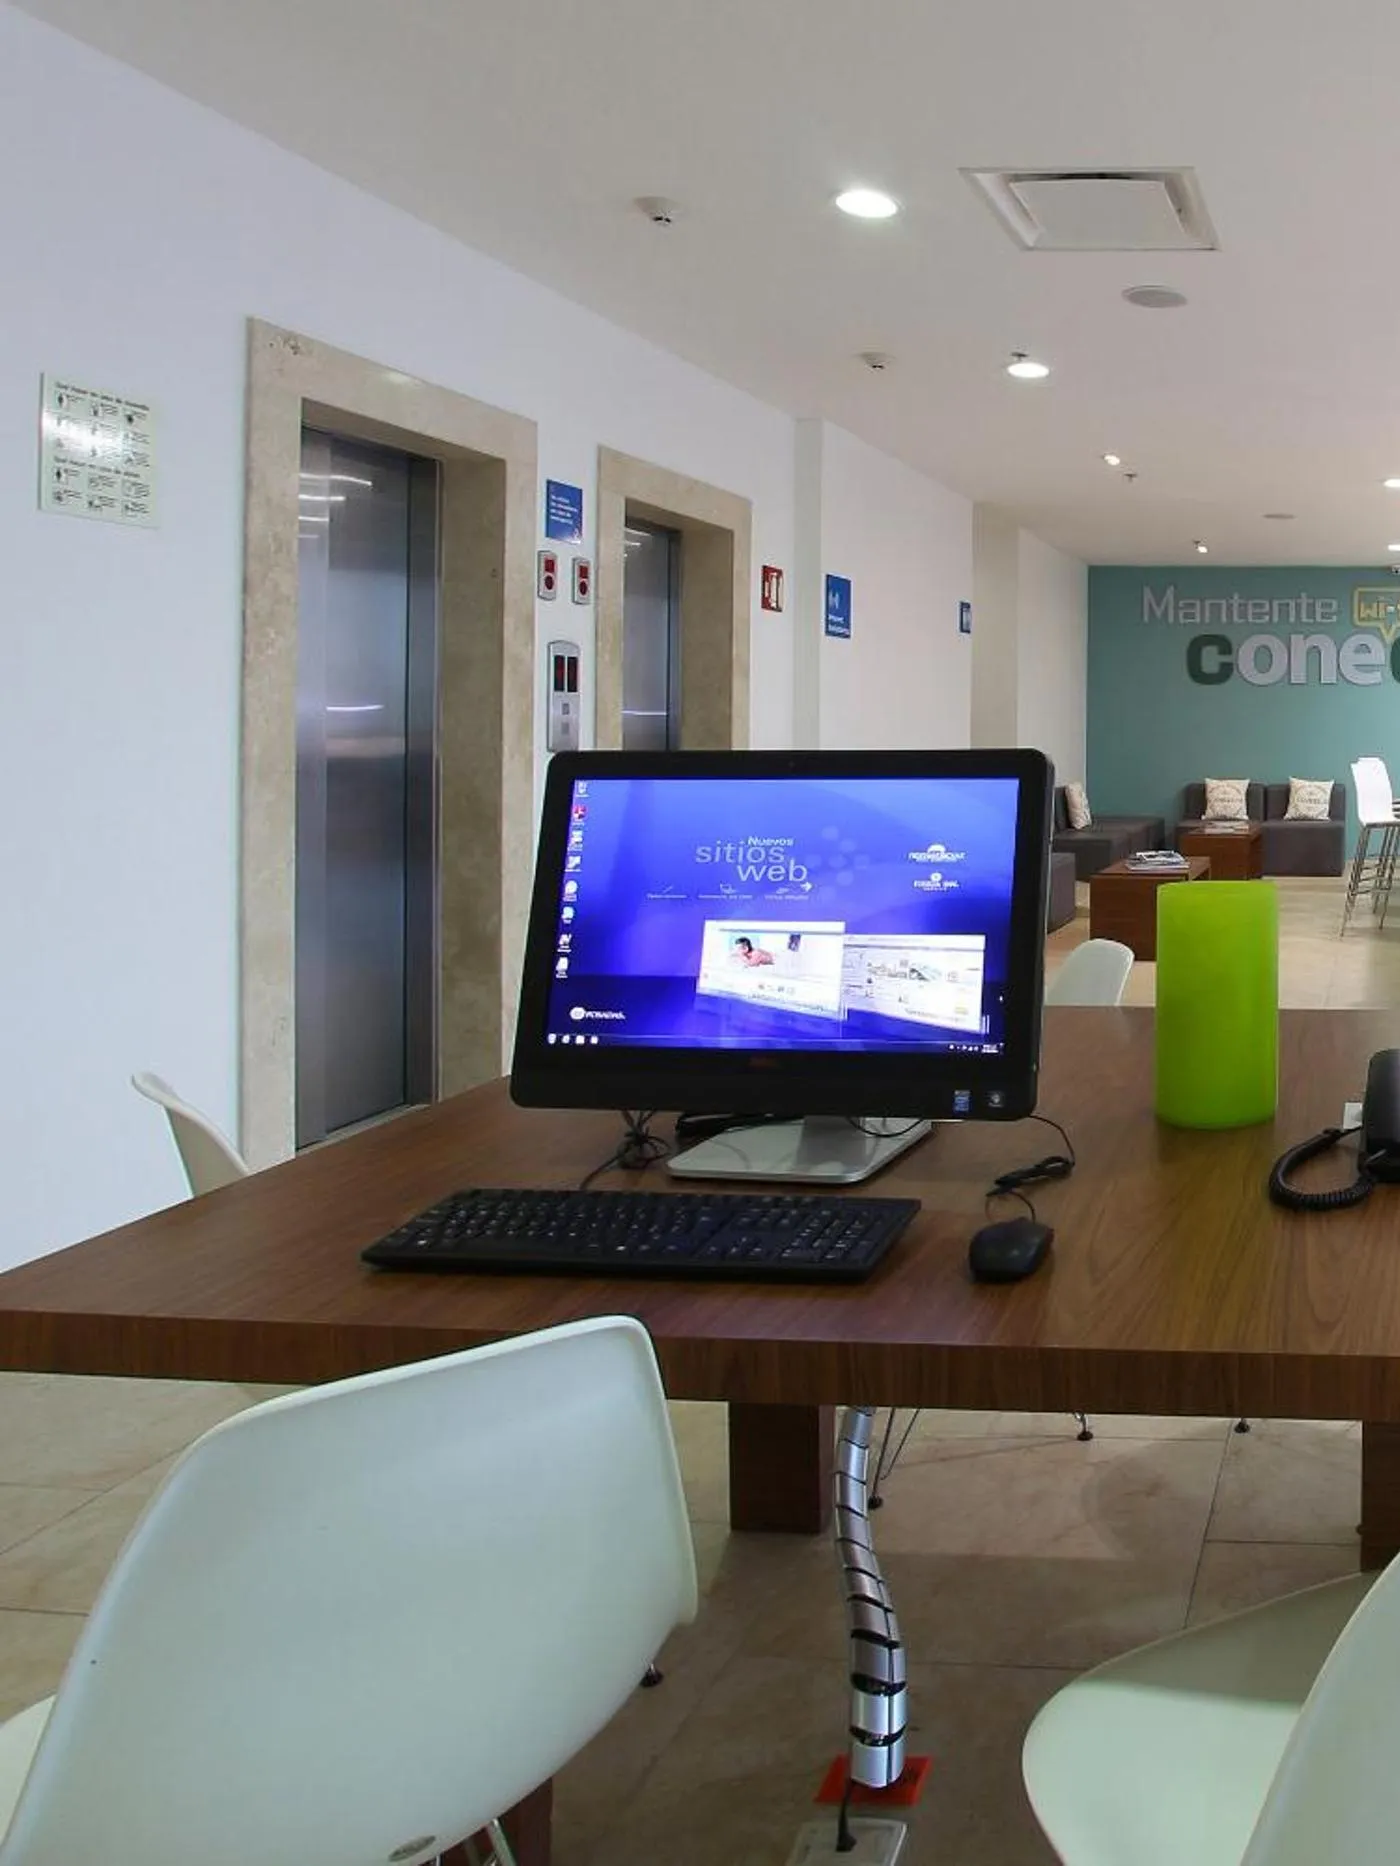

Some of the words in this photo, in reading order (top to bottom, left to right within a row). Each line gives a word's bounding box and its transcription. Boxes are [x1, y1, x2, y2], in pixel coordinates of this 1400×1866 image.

[1142, 585, 1338, 625] Mantente
[695, 840, 786, 863] sitios
[736, 858, 809, 882] web
